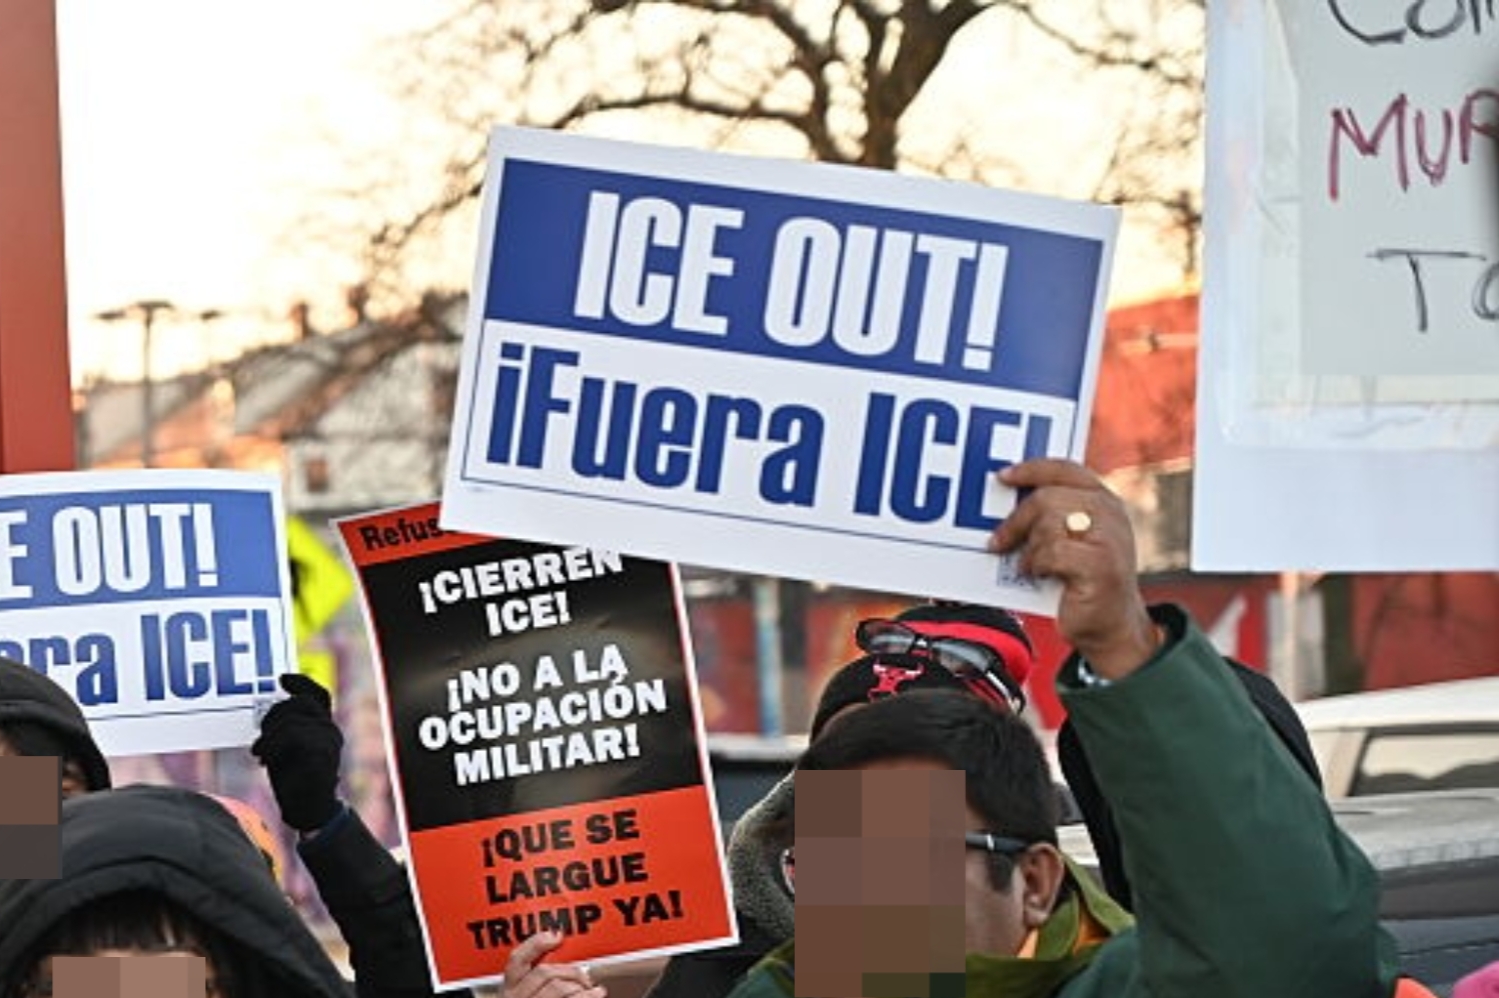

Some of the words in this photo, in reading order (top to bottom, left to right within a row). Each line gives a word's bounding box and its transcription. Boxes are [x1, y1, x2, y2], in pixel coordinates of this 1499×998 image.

[573, 191, 745, 337] ICE
[763, 217, 1009, 372] OUT!
[52, 503, 219, 596] OUT!
[358, 517, 444, 552] Refus
[419, 546, 623, 612] ¡CIERREN
[485, 590, 572, 637] ICE!
[140, 608, 276, 702] ICE!
[447, 664, 520, 713] ¡NO
[534, 655, 563, 691] A
[574, 644, 629, 683] LA
[419, 674, 668, 750] OCUPACIÓN
[454, 723, 641, 786] MILITAR!
[481, 813, 575, 869] ¡QUE
[586, 808, 641, 846] SE
[486, 852, 649, 906] LARGUE
[467, 903, 602, 951] TRUMP
[616, 891, 684, 927] YA!
